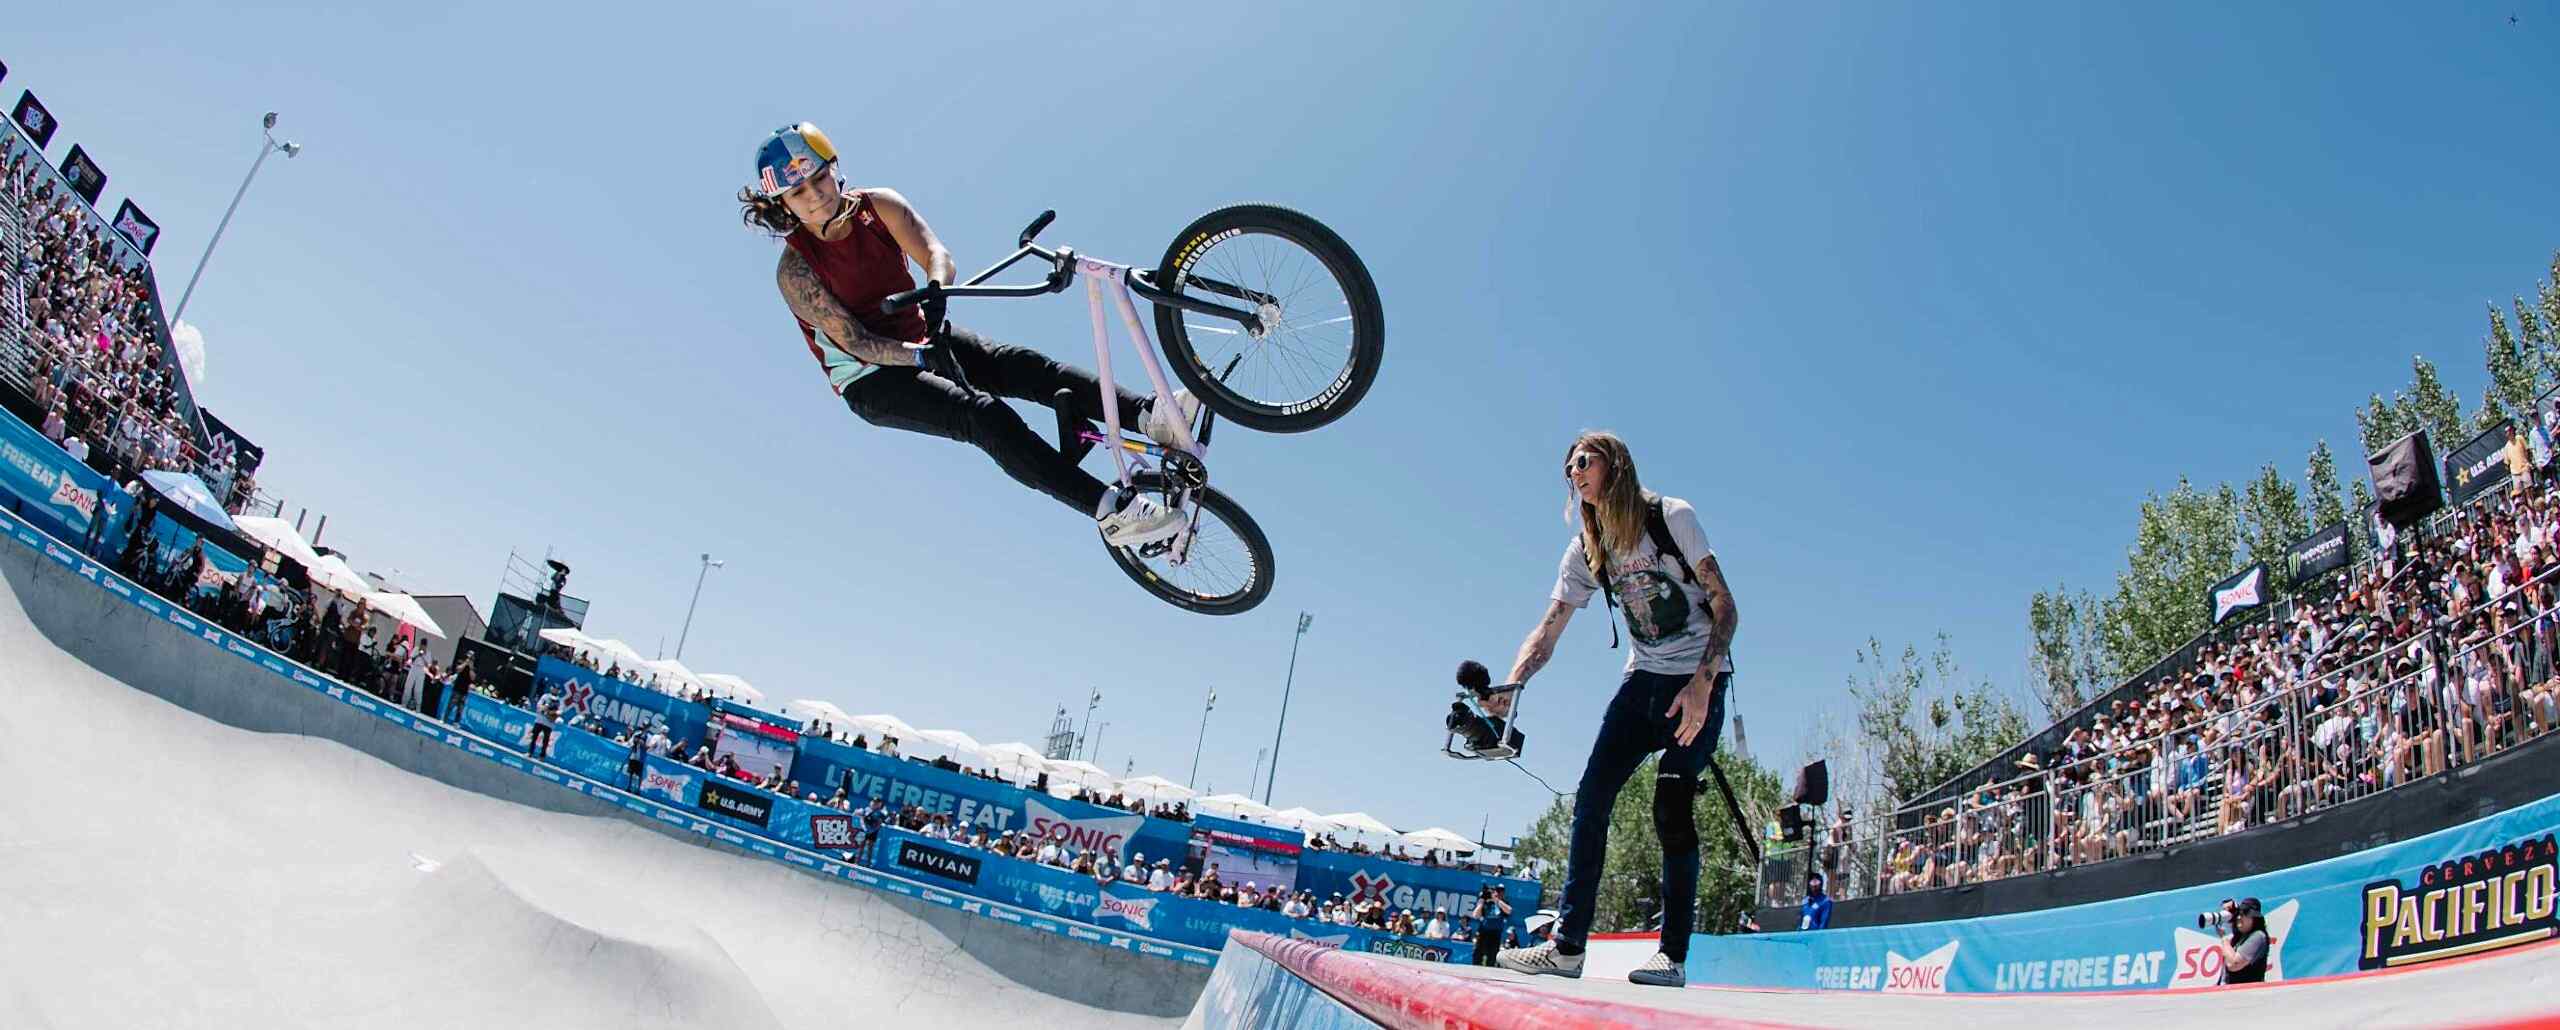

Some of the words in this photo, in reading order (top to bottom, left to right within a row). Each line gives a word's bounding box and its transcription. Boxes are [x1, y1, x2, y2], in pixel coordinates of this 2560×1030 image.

[1173, 231, 1209, 270] MAXXIS
[591, 694, 666, 735] GAMES
[649, 774, 682, 792] SONIC
[736, 802, 765, 818] ARMY
[825, 764, 886, 799] LIVE
[889, 777, 956, 816] FREE
[957, 798, 1015, 831] EAT
[815, 819, 848, 835] TECH
[817, 831, 851, 846] DECK
[1028, 817, 1123, 856] SONIC
[905, 849, 973, 876] RIVIAN
[2423, 839, 2556, 886] CERVEZA
[1101, 900, 1148, 919] SONIC
[1393, 885, 1480, 919] GAME
[2365, 863, 2558, 960] PACIFICO
[1184, 917, 1219, 935] LIVE
[1815, 965, 1849, 989] FREE
[1848, 965, 1882, 990] EAT
[1887, 965, 1944, 989] SONIC
[1995, 960, 2048, 991] LIVE
[2049, 956, 2111, 989] FREE
[2112, 950, 2166, 986] EAT
